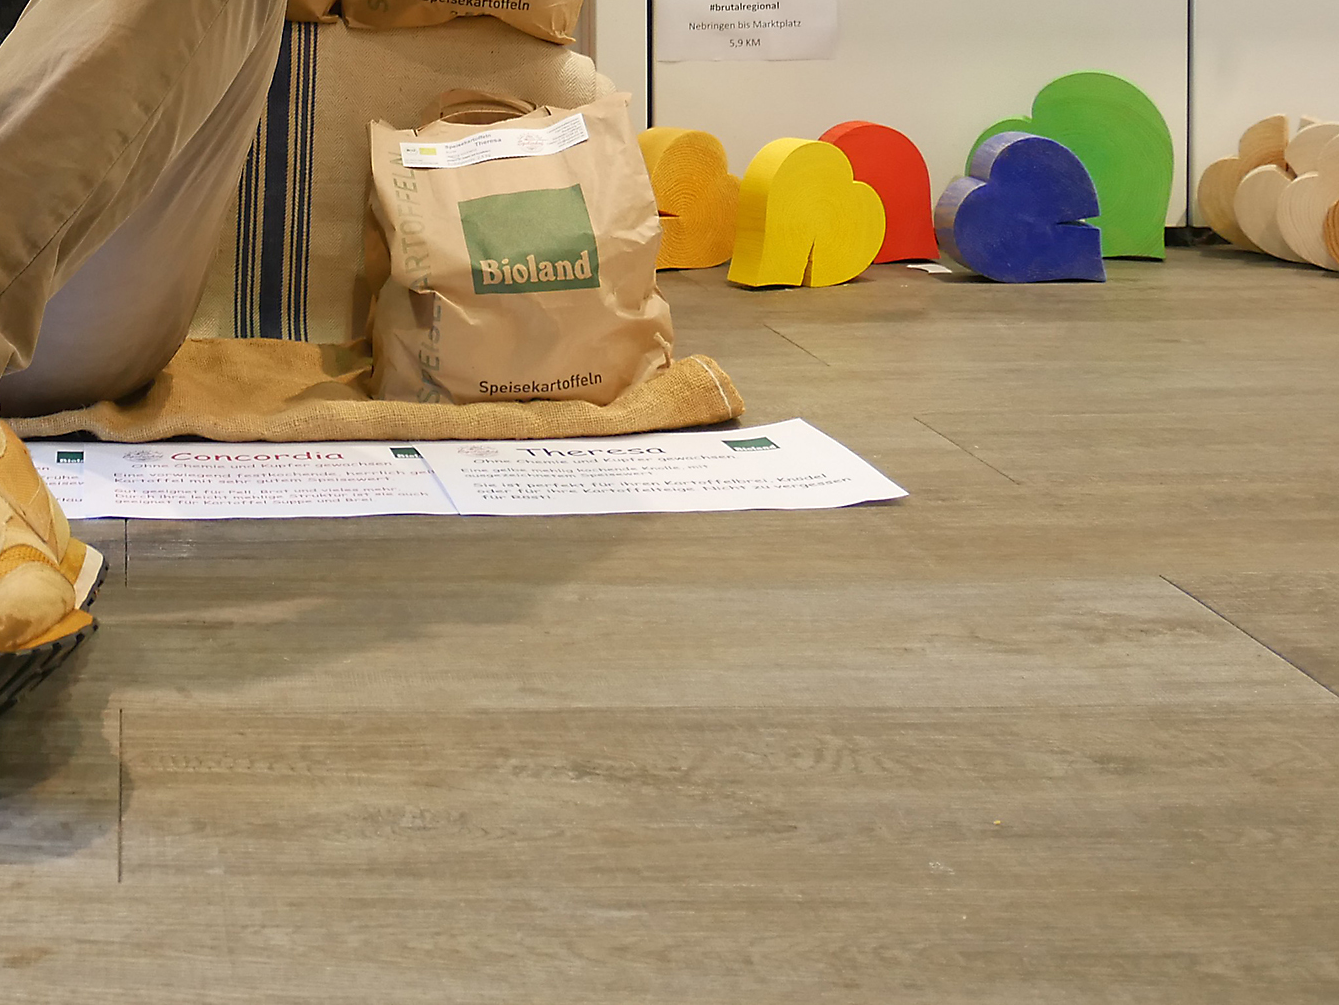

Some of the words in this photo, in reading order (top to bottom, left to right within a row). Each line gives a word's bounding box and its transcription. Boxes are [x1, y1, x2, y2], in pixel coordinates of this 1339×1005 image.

[709, 2, 780, 12] #brutalregional
[688, 21, 736, 32] Nebringen
[738, 20, 751, 29] bis
[752, 19, 802, 29] Marktplatz
[729, 39, 744, 48] 5,9
[745, 38, 761, 47] KM
[479, 250, 592, 286] Bioland
[479, 372, 602, 396] Speisekartoffeln
[171, 451, 345, 461] Concordia
[515, 447, 667, 458] Theresa
[314, 461, 393, 469] gewachsen
[516, 458, 569, 466] Chemie
[603, 456, 653, 464] Kupfer
[576, 465, 638, 473] kochende
[255, 477, 303, 485] gutem
[776, 472, 827, 483] Knödel
[774, 476, 852, 490] vergessen
